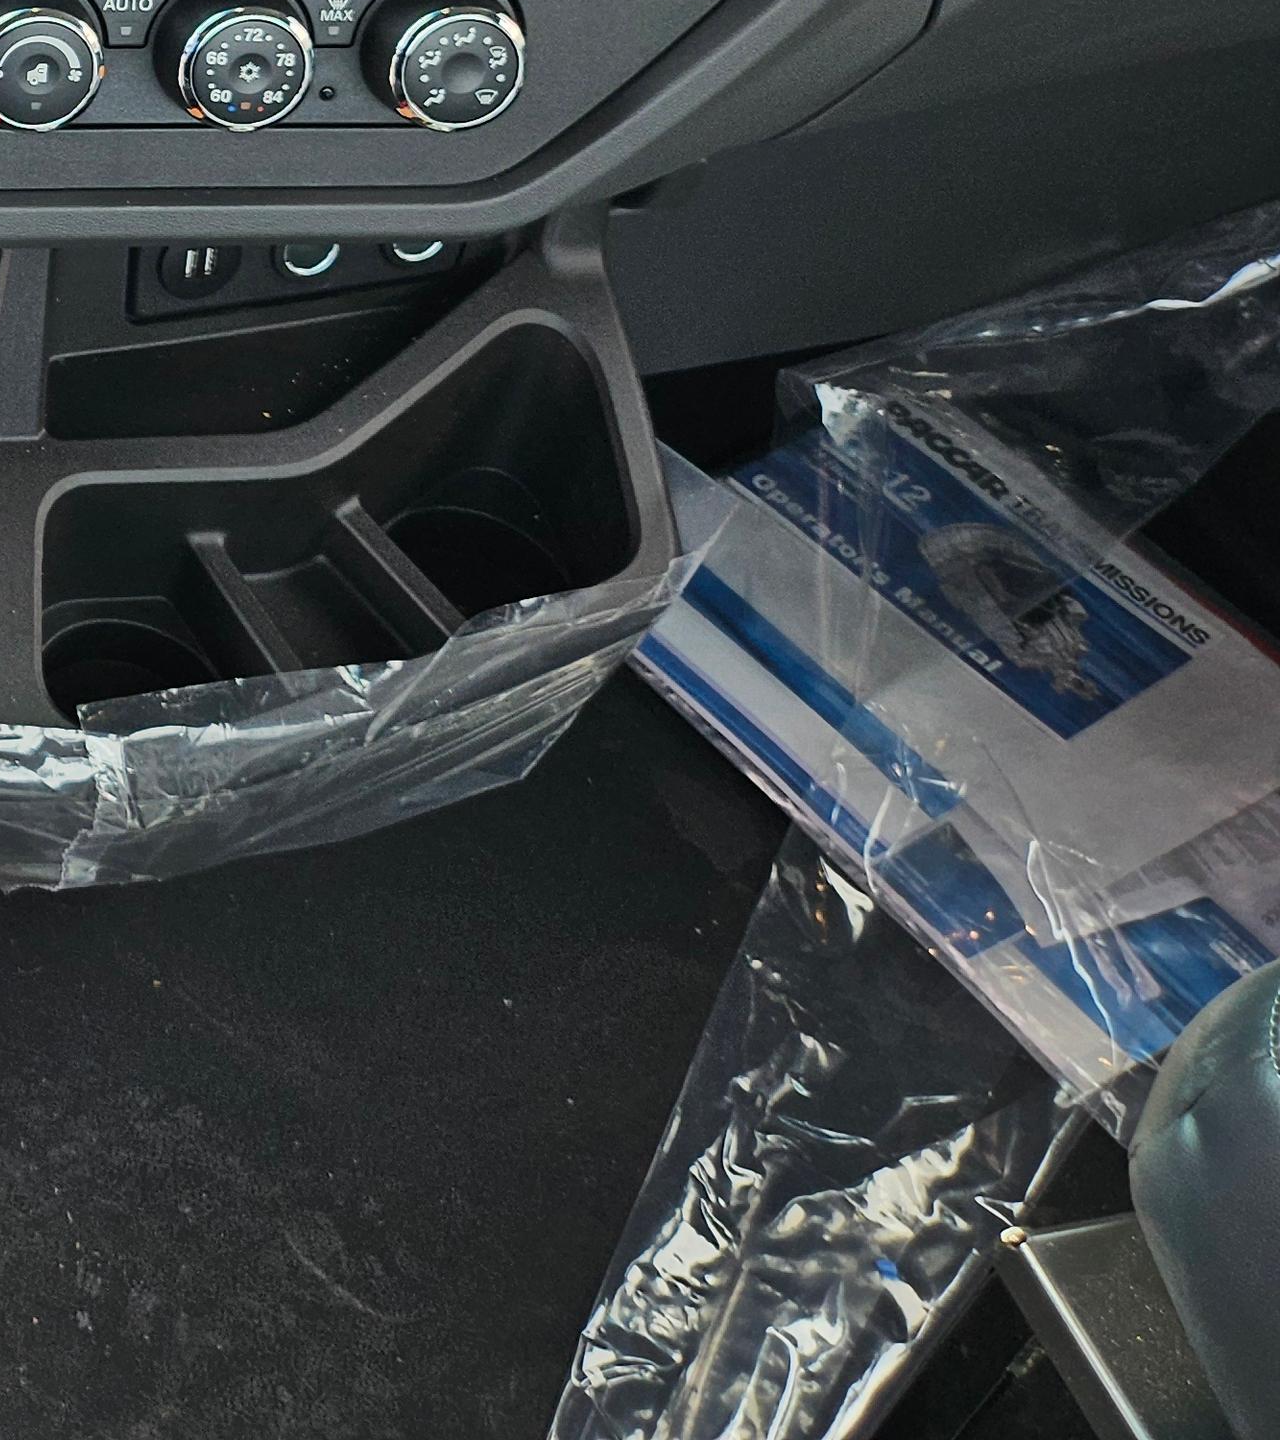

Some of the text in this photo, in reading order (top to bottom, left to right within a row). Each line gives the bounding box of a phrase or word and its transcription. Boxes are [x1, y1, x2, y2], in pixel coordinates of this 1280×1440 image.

[320, 10, 353, 22] MAX
[243, 28, 264, 42] 72
[206, 51, 228, 65] 66
[276, 53, 296, 67] 78
[210, 89, 232, 103] 60
[262, 90, 284, 104] 84
[895, 586, 1004, 673] Manual
